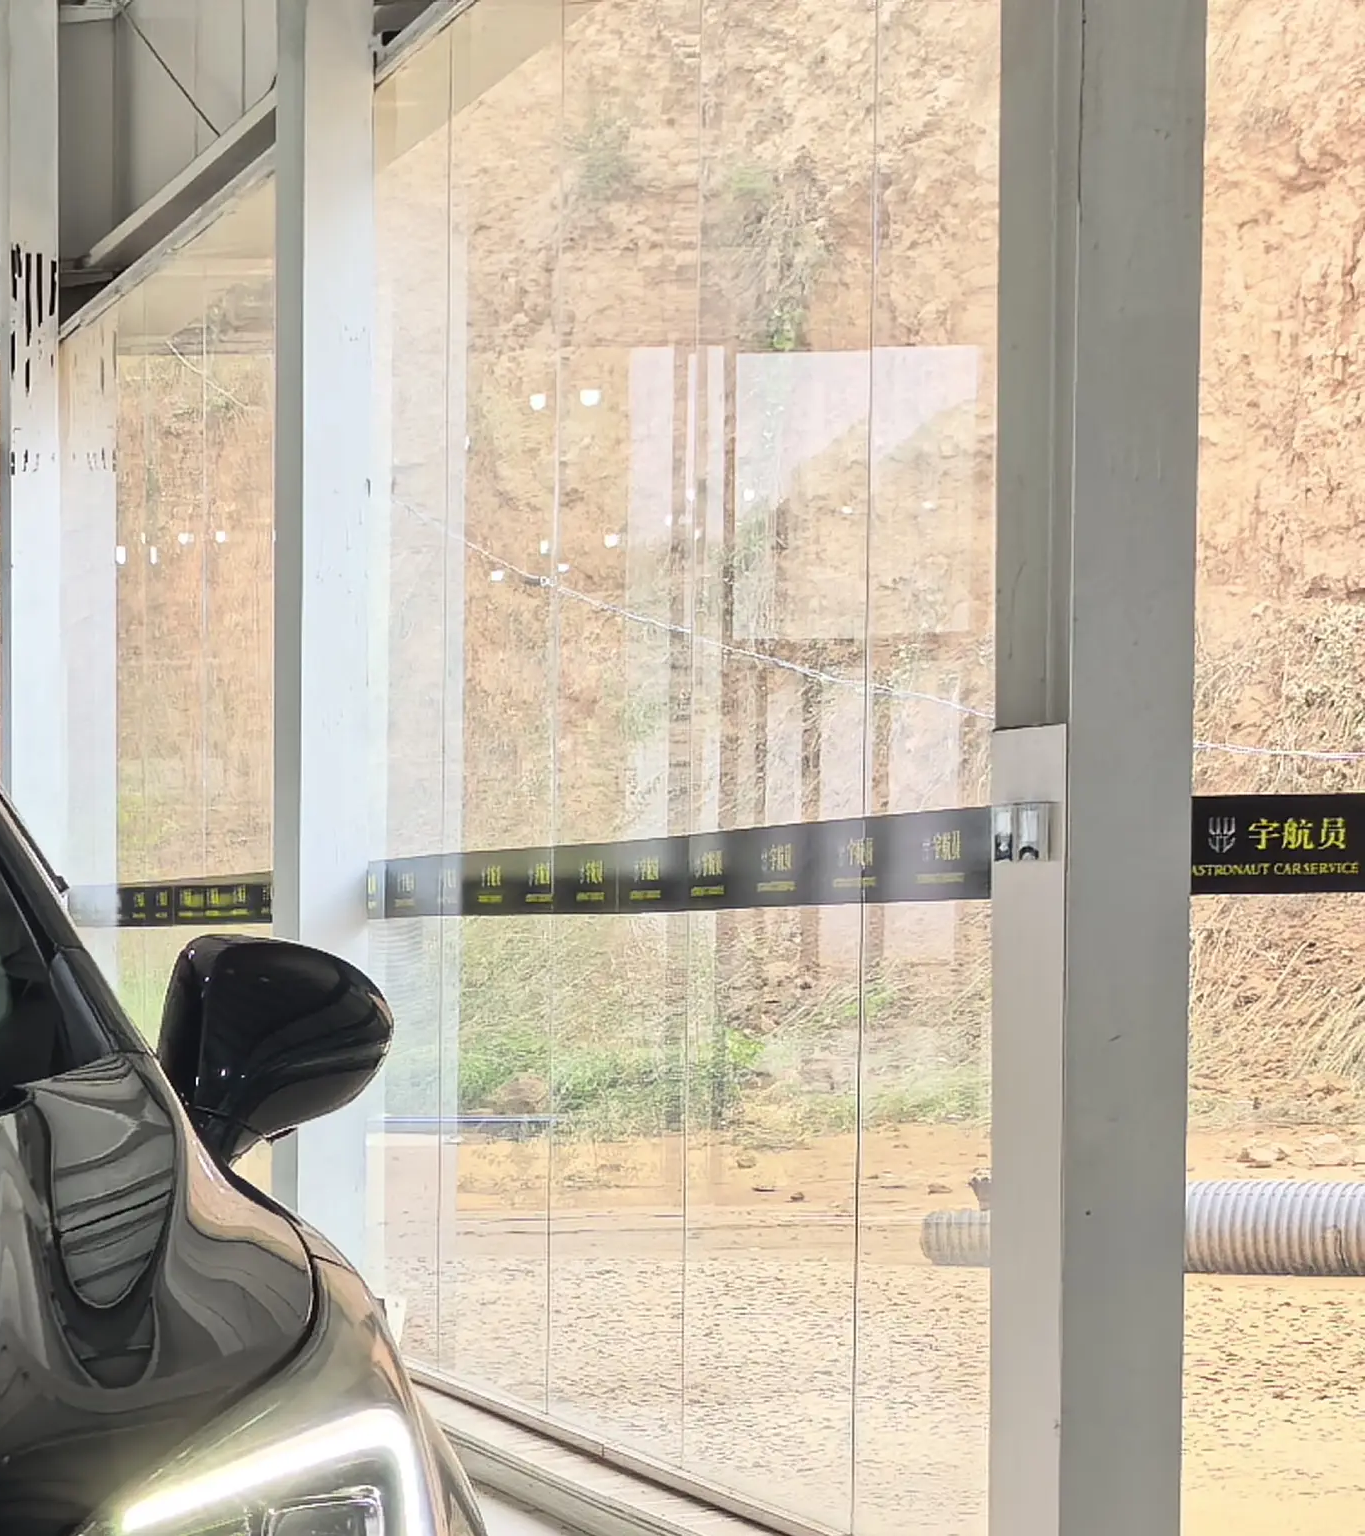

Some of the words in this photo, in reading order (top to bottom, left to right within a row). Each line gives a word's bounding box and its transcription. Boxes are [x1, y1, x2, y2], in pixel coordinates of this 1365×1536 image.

[1248, 817, 1347, 850] 宇航员
[1191, 863, 1270, 876] ASTRONAUT
